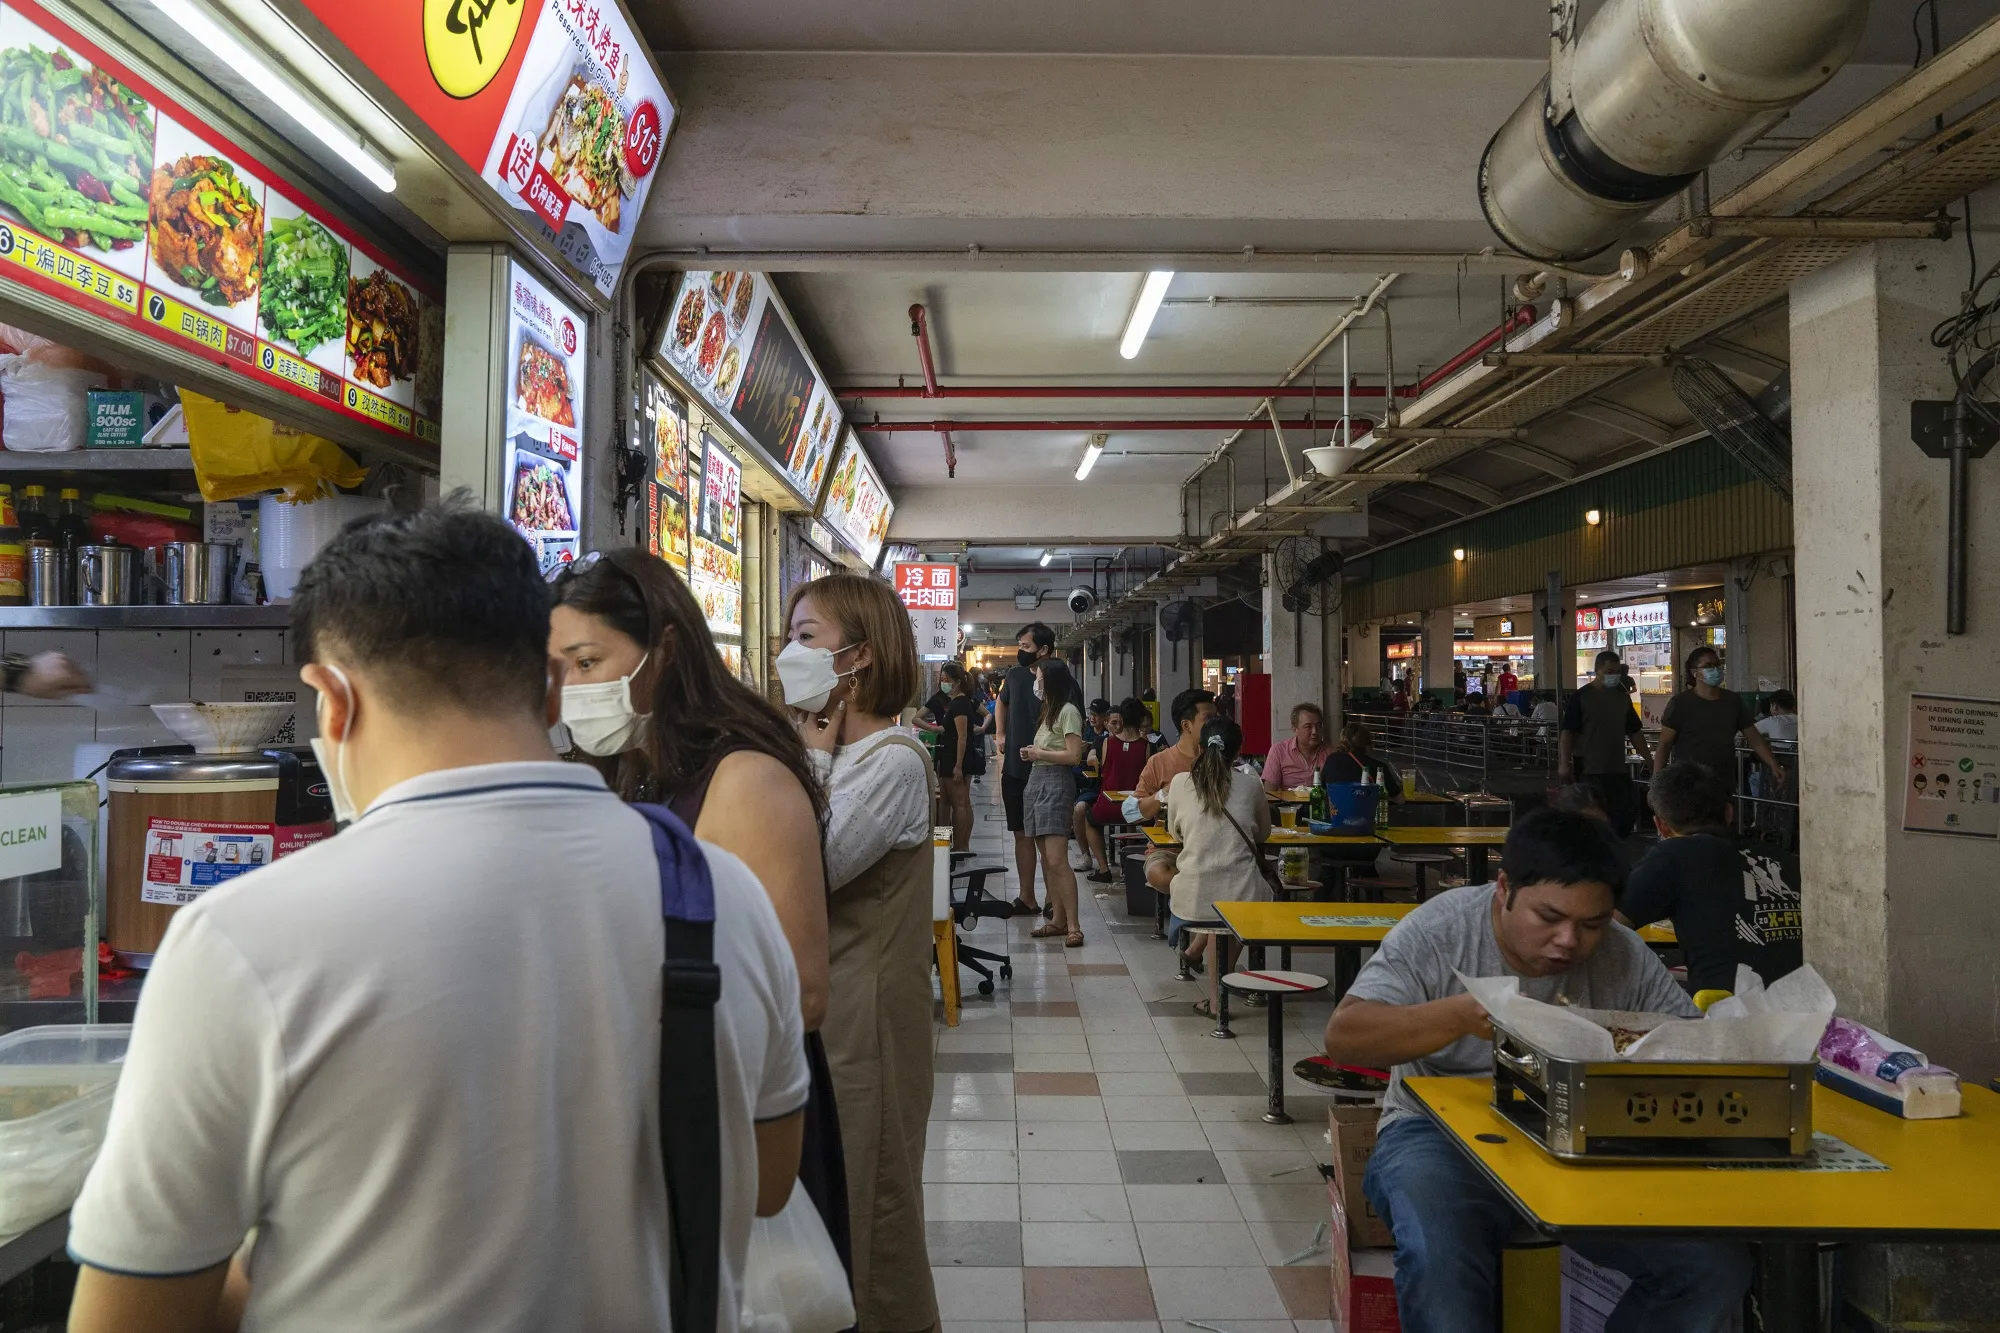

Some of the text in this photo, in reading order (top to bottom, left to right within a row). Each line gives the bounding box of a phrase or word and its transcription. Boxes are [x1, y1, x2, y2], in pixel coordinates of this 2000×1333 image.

[552, 1, 627, 116] Preserved Veg Grilled Fish
[629, 113, 657, 165] $15
[510, 138, 534, 185] 送
[16, 235, 111, 298] 干煸四季豆
[117, 284, 133, 303] $5
[182, 311, 222, 347] 回锅肉
[227, 334, 252, 357] $7.00
[320, 376, 339, 396] $4.00
[97, 405, 130, 415] FILM
[398, 413, 409, 427] $10
[899, 588, 954, 607] 牛肉面
[1929, 706, 1953, 714] EATING
[1965, 709, 1998, 718] DRINKING
[1937, 716, 1962, 724] DINING
[1930, 725, 1965, 734] TAKEAWAY
[0, 825, 47, 846] CLEAN
